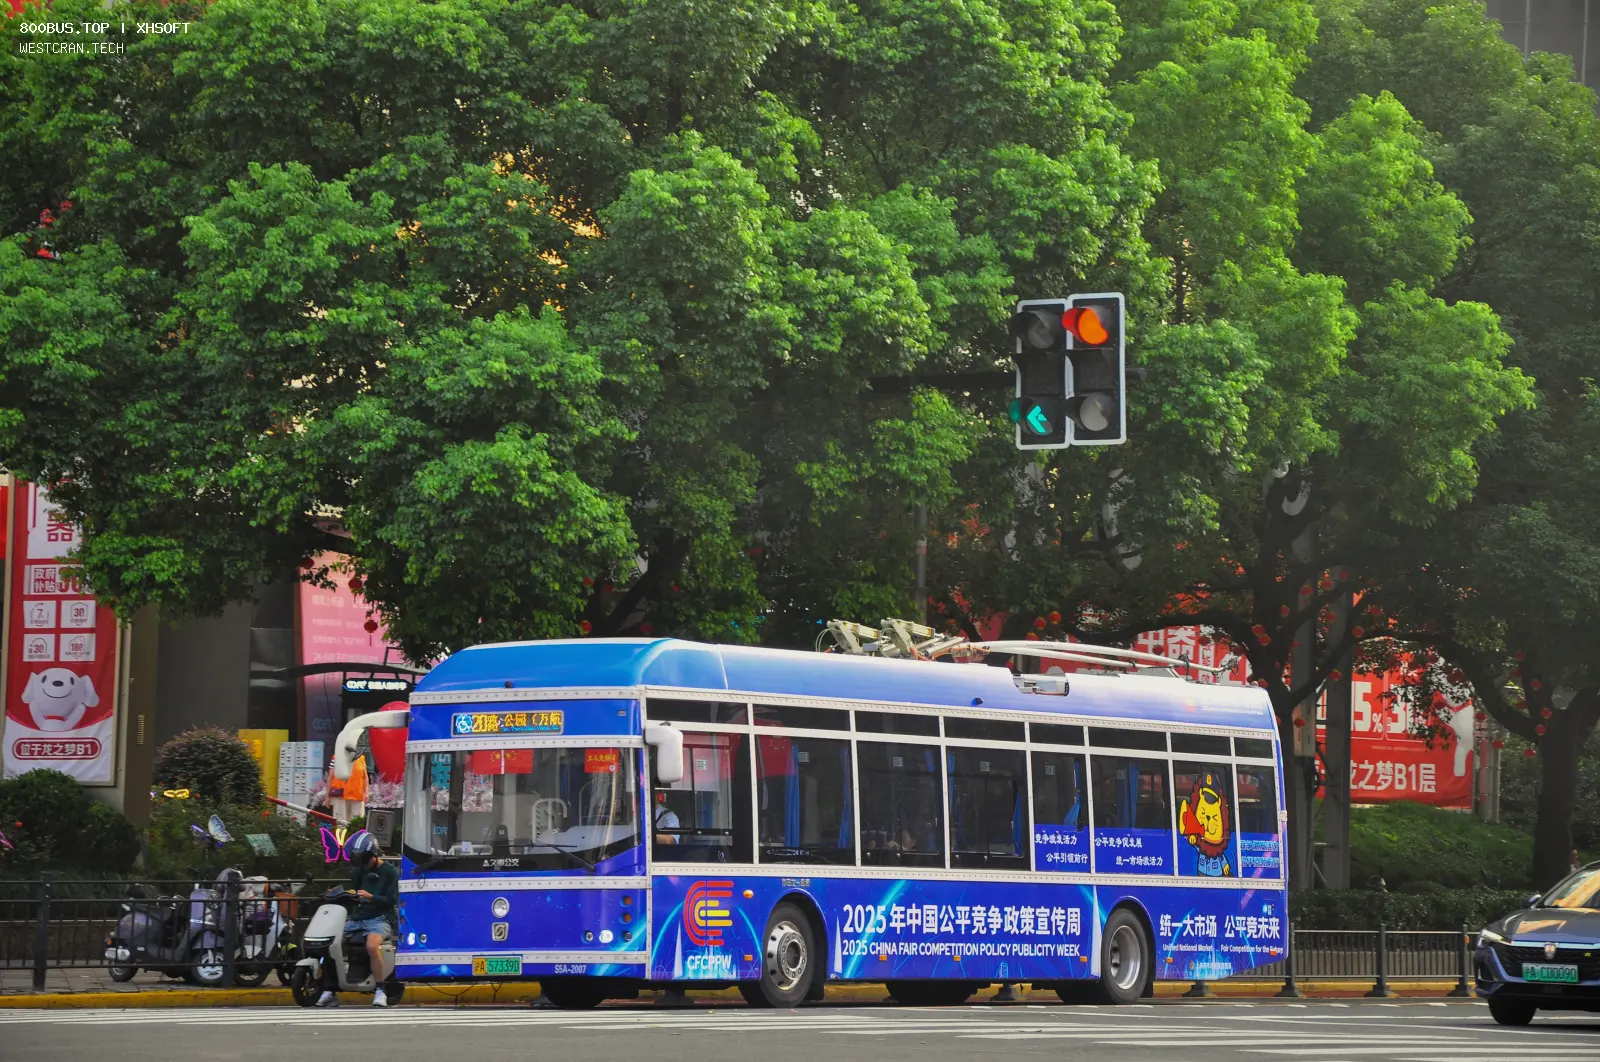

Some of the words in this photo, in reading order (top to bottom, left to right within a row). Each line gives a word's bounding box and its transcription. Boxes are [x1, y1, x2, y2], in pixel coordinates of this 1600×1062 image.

[1094, 837, 1143, 848] 公平竞争促发展
[1046, 852, 1088, 864] 公平引领前行
[1116, 855, 1163, 866] 统一市场激活力
[1160, 914, 1217, 937] 统一大市场
[1224, 915, 1280, 939] 公平竞未来
[842, 940, 868, 955] 2025
[869, 941, 898, 955] CHINA
[899, 942, 918, 955] FAIR
[919, 942, 979, 956] COMPETITION
[981, 943, 1011, 956] POLICY
[1012, 943, 1055, 956] PUBLICITY
[1056, 944, 1080, 956] WEEK
[686, 954, 732, 970] CFCPPW
[554, 964, 587, 974] S5A-2007
